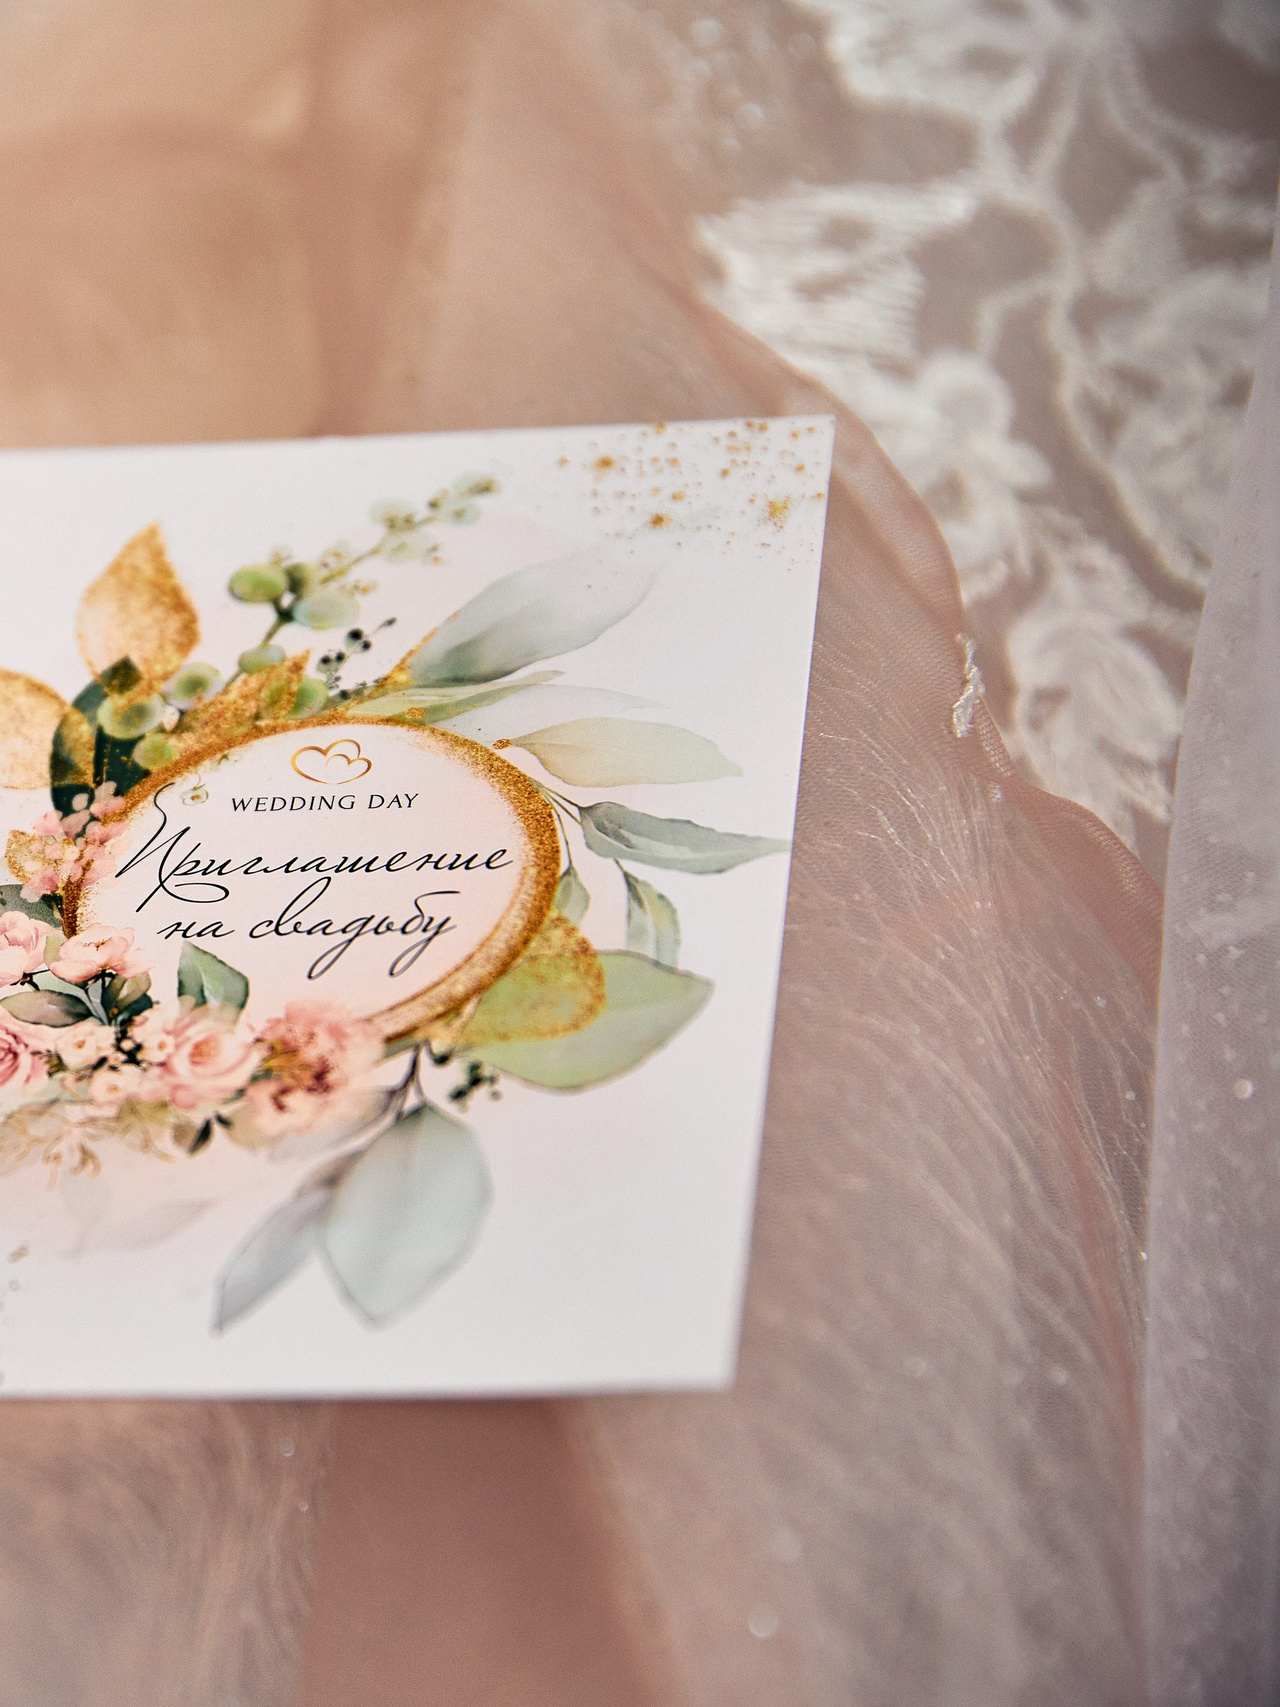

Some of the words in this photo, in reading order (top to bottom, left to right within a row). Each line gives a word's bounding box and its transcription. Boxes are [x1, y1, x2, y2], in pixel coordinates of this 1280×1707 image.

[114, 782, 514, 913] Приглашение
[231, 794, 356, 813] WEDDING
[367, 792, 419, 810] DAY
[156, 916, 235, 940] на
[249, 876, 461, 981] свадьбу
